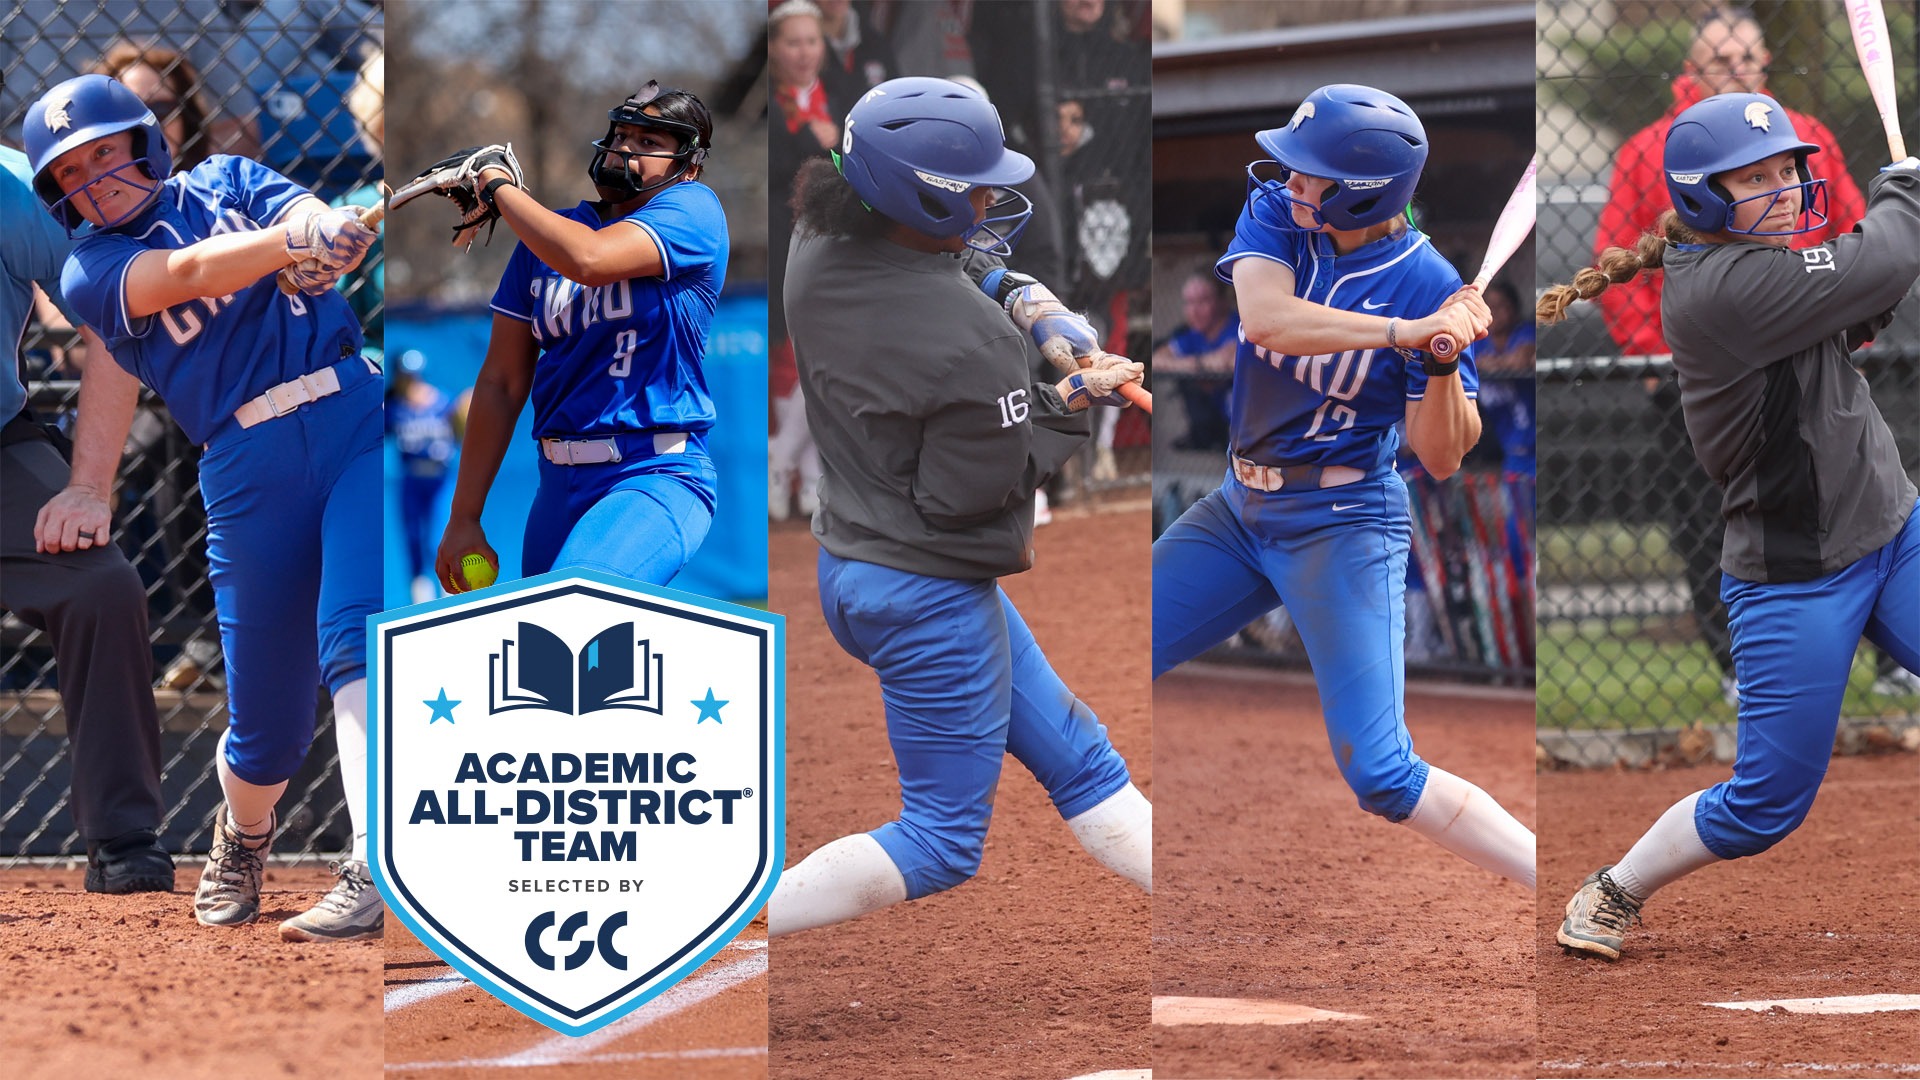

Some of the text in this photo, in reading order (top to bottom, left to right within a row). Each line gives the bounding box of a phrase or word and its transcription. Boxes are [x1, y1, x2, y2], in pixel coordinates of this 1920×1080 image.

[1802, 247, 1836, 274] 19
[608, 329, 637, 378] 9
[997, 388, 1029, 429] 16
